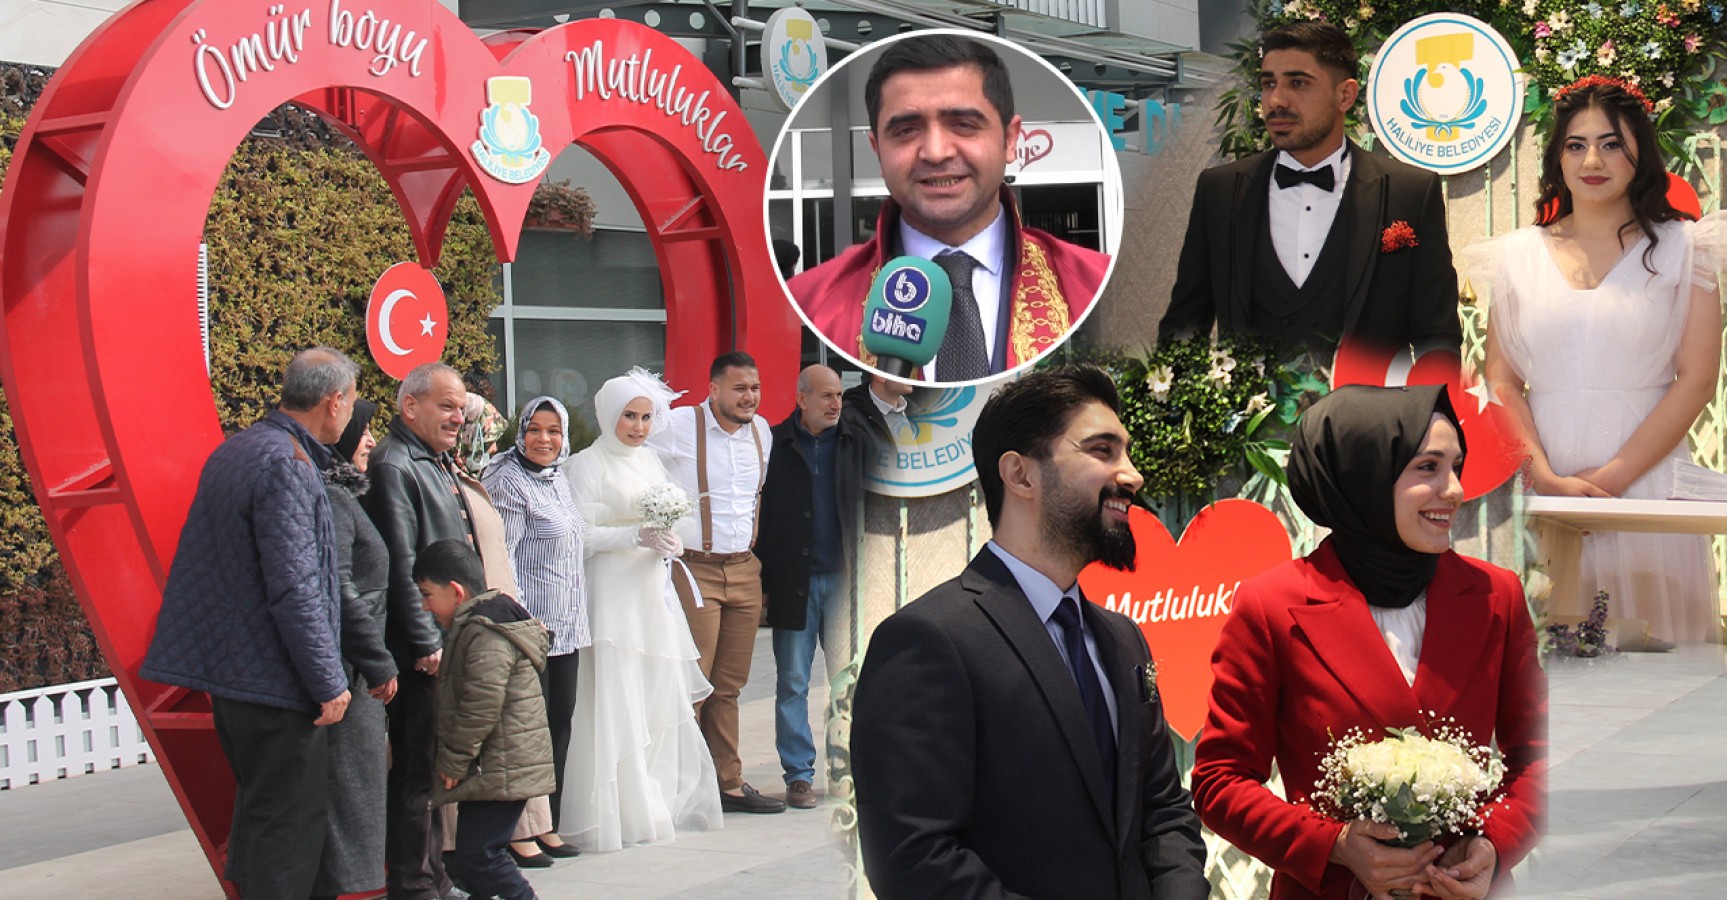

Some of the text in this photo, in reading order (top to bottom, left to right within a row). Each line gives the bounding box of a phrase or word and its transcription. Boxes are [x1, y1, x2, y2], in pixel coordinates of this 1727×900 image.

[191, 0, 428, 110] Ömür boyu
[564, 40, 748, 173] Mutluluklar
[1386, 115, 1502, 158] HALİLİYE BELEDİYESİ
